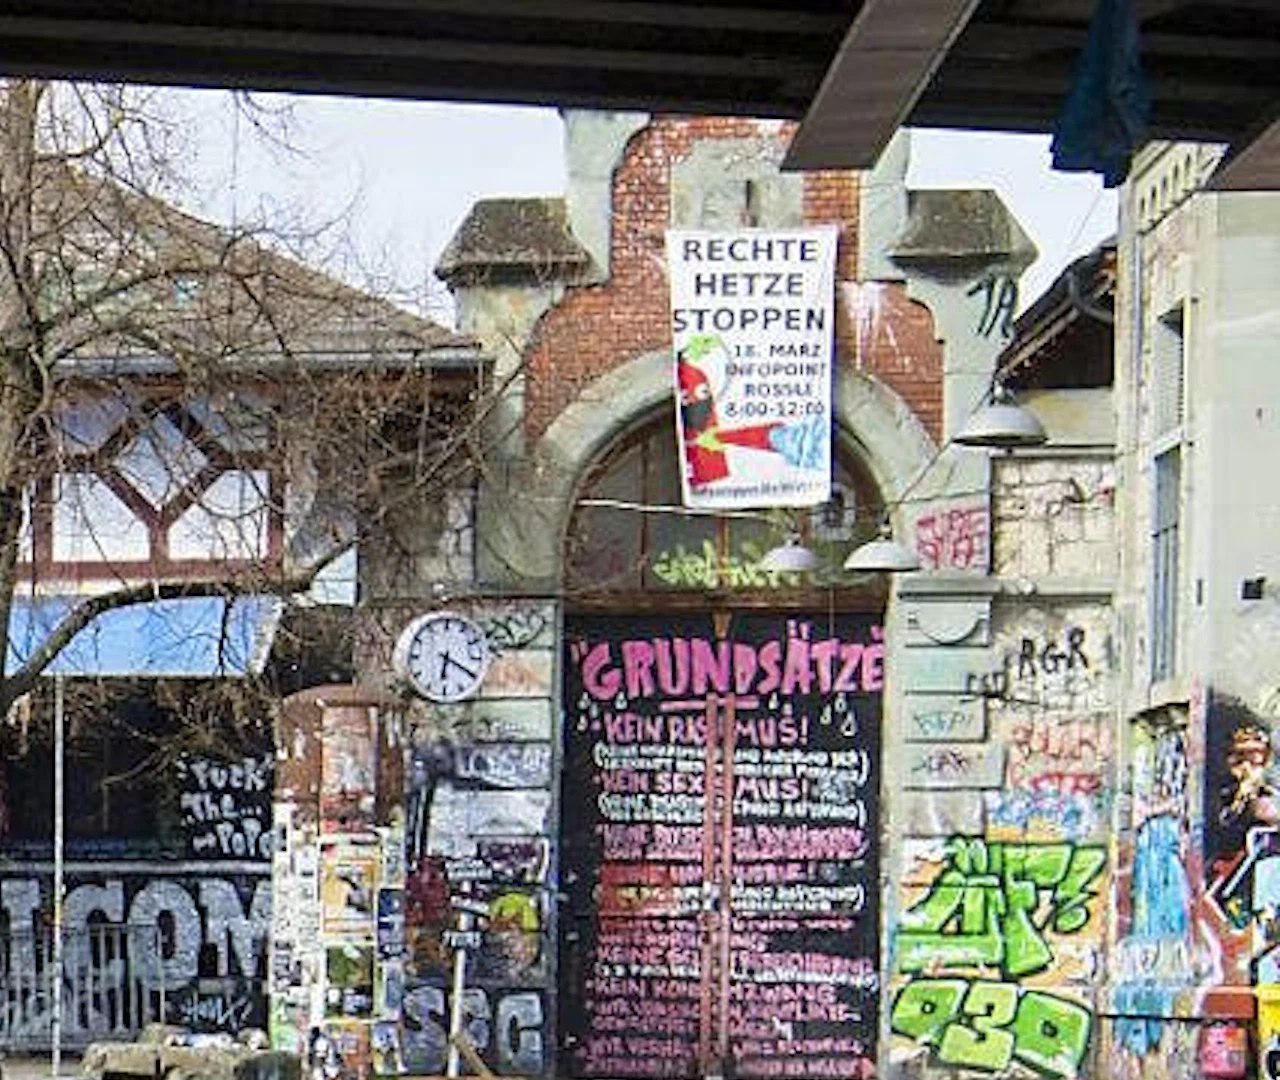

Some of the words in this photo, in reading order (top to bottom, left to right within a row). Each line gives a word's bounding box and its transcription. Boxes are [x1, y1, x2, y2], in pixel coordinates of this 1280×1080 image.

[683, 238, 818, 262] RECHTE
[694, 273, 805, 297] HETZE
[673, 307, 825, 332] STOPPEN
